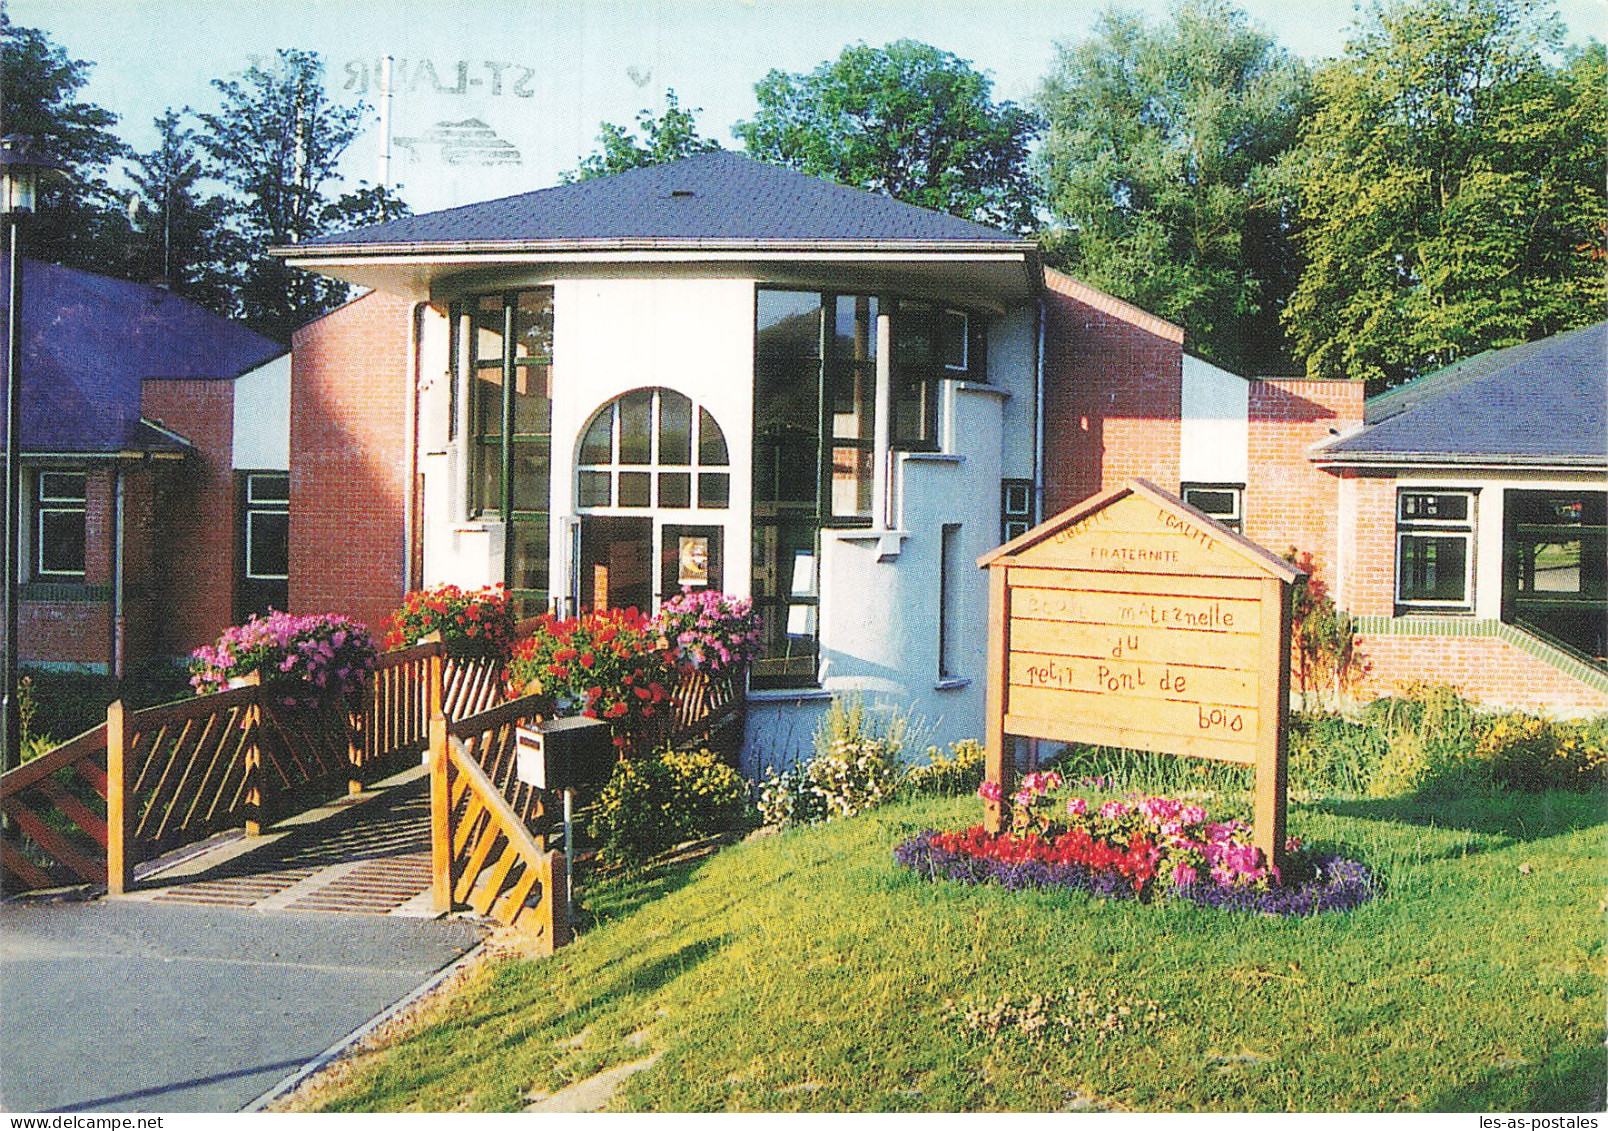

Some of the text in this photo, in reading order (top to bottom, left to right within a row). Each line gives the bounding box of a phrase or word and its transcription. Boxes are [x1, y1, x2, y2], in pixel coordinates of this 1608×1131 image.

[1090, 546, 1179, 563] FRATERNITE
[1111, 636, 1138, 658] du
[1159, 669, 1187, 693] de
